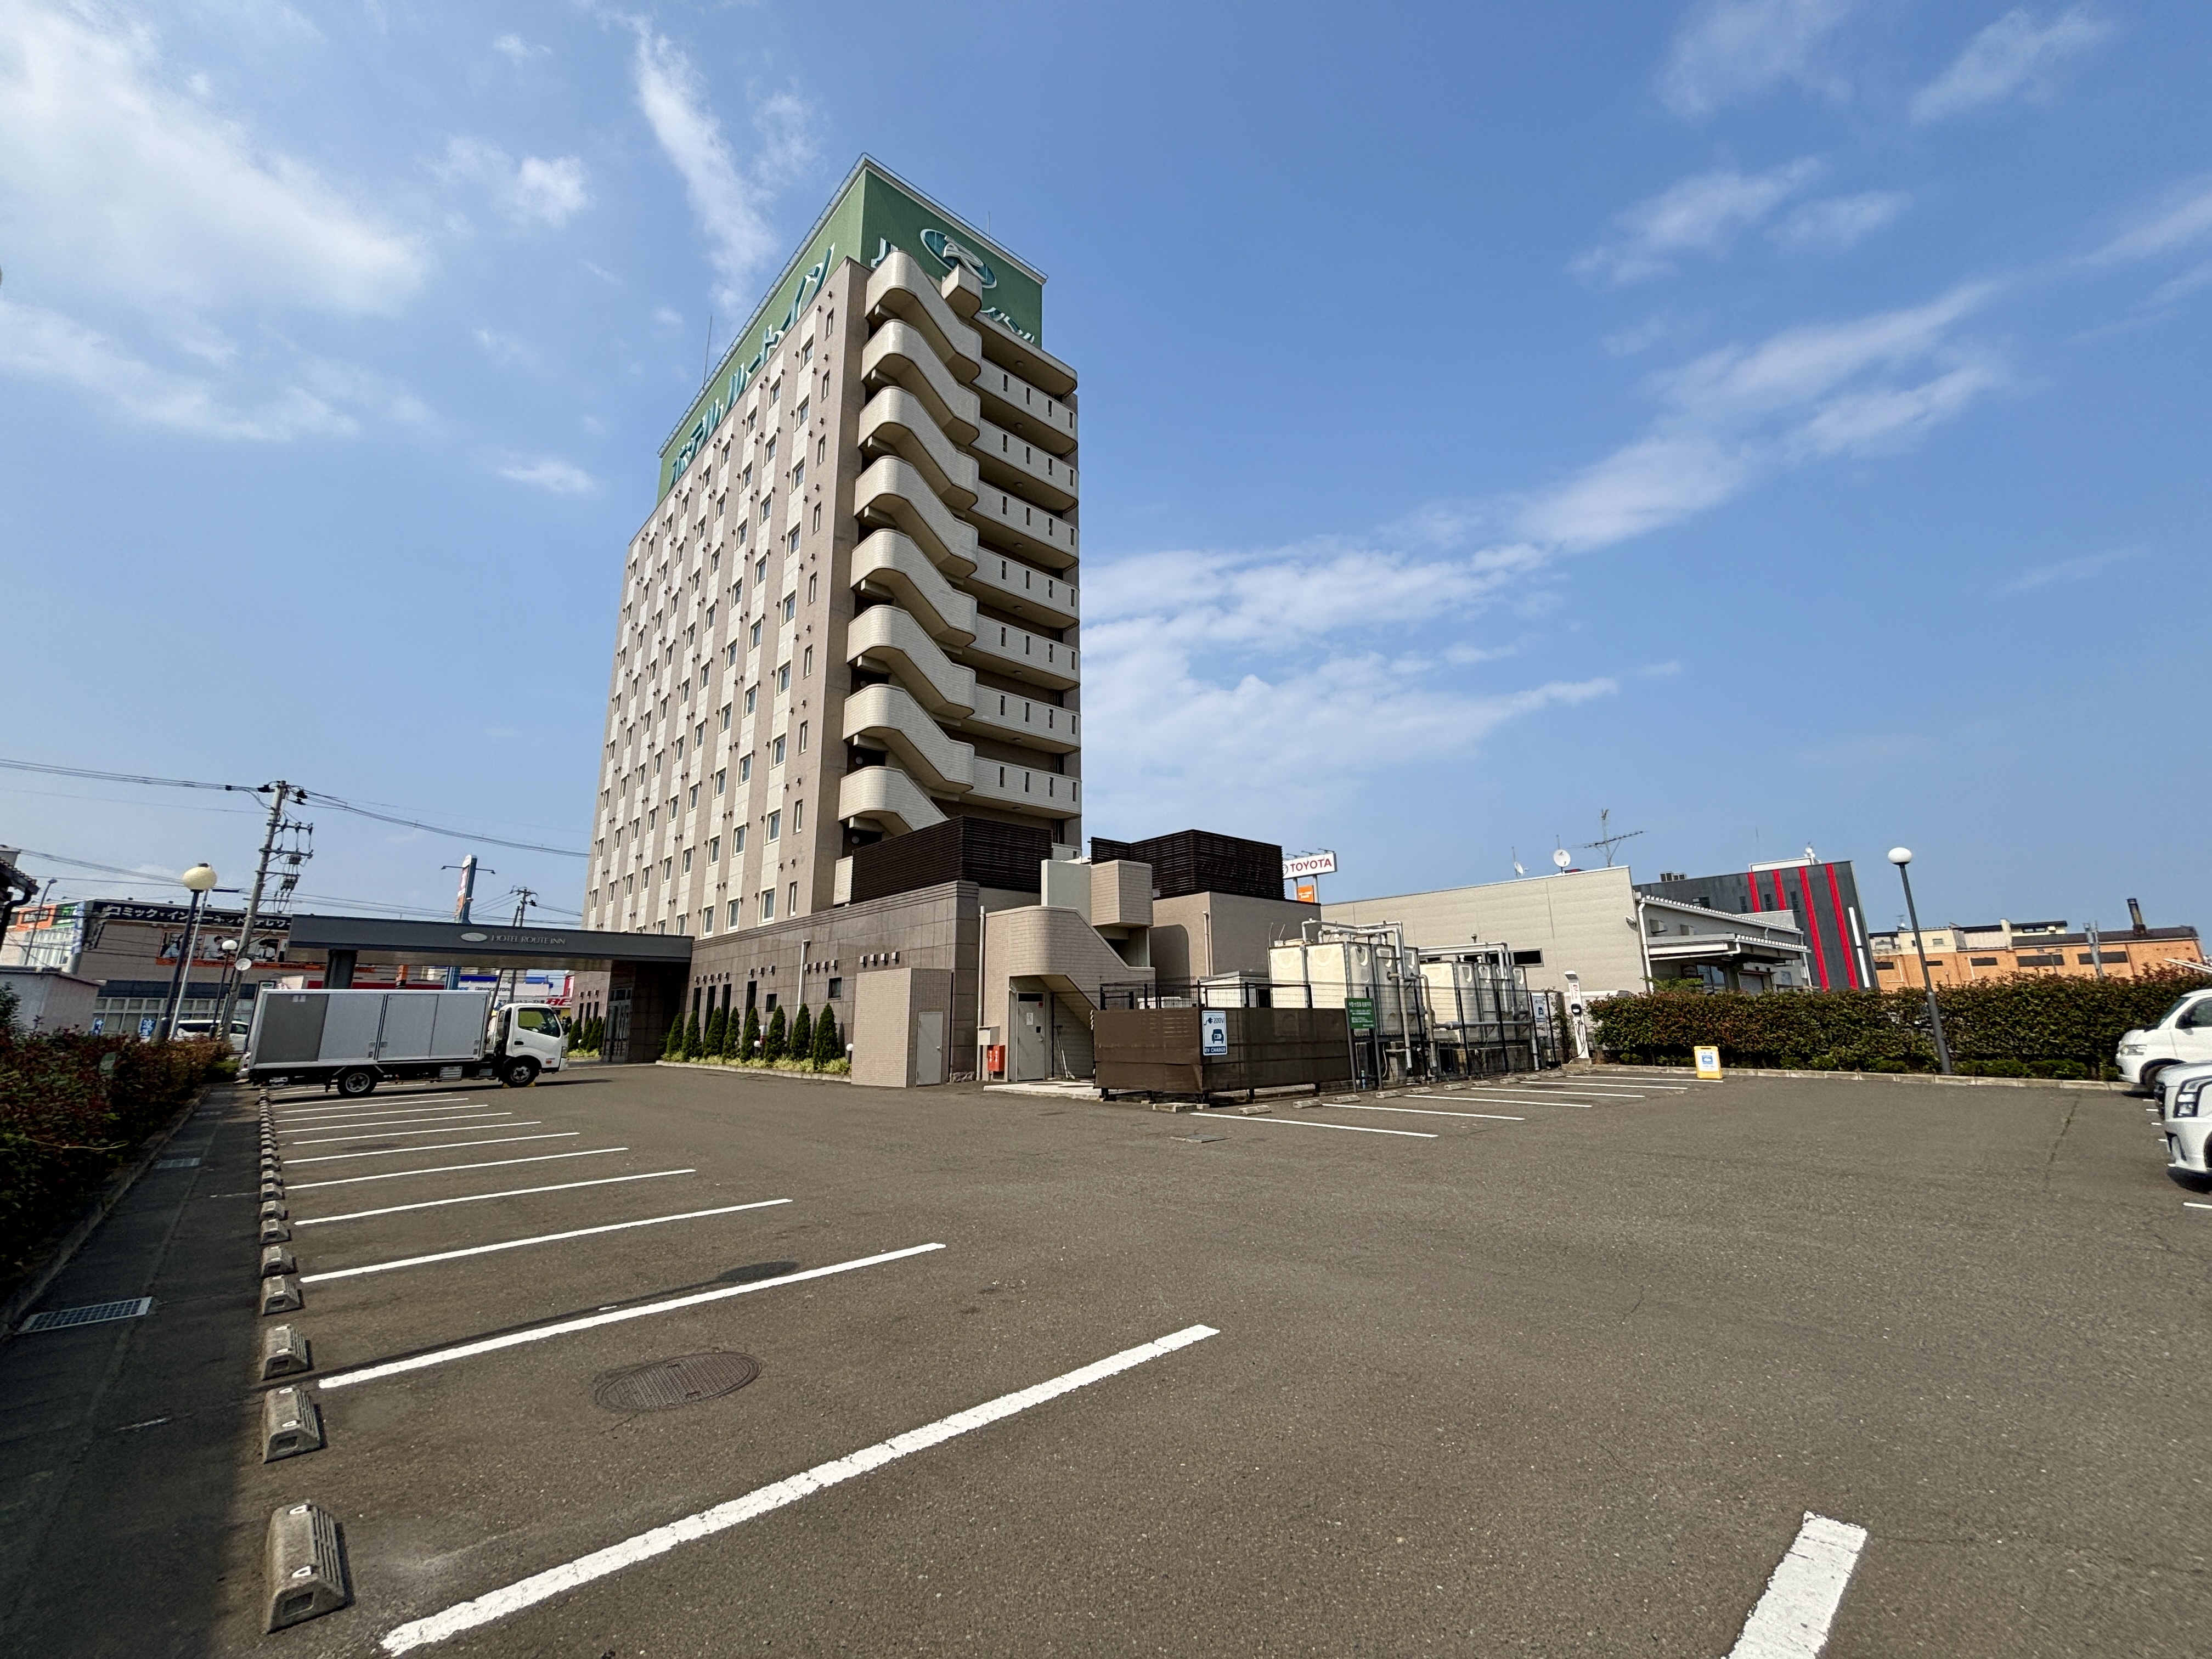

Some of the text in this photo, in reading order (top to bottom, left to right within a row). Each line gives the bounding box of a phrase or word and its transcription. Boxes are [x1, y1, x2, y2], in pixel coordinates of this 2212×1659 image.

[1290, 859, 1332, 872] TOYOTA
[491, 934, 518, 943] HOTEL
[521, 936, 549, 944] ROUTE
[546, 998, 572, 1006] BE
